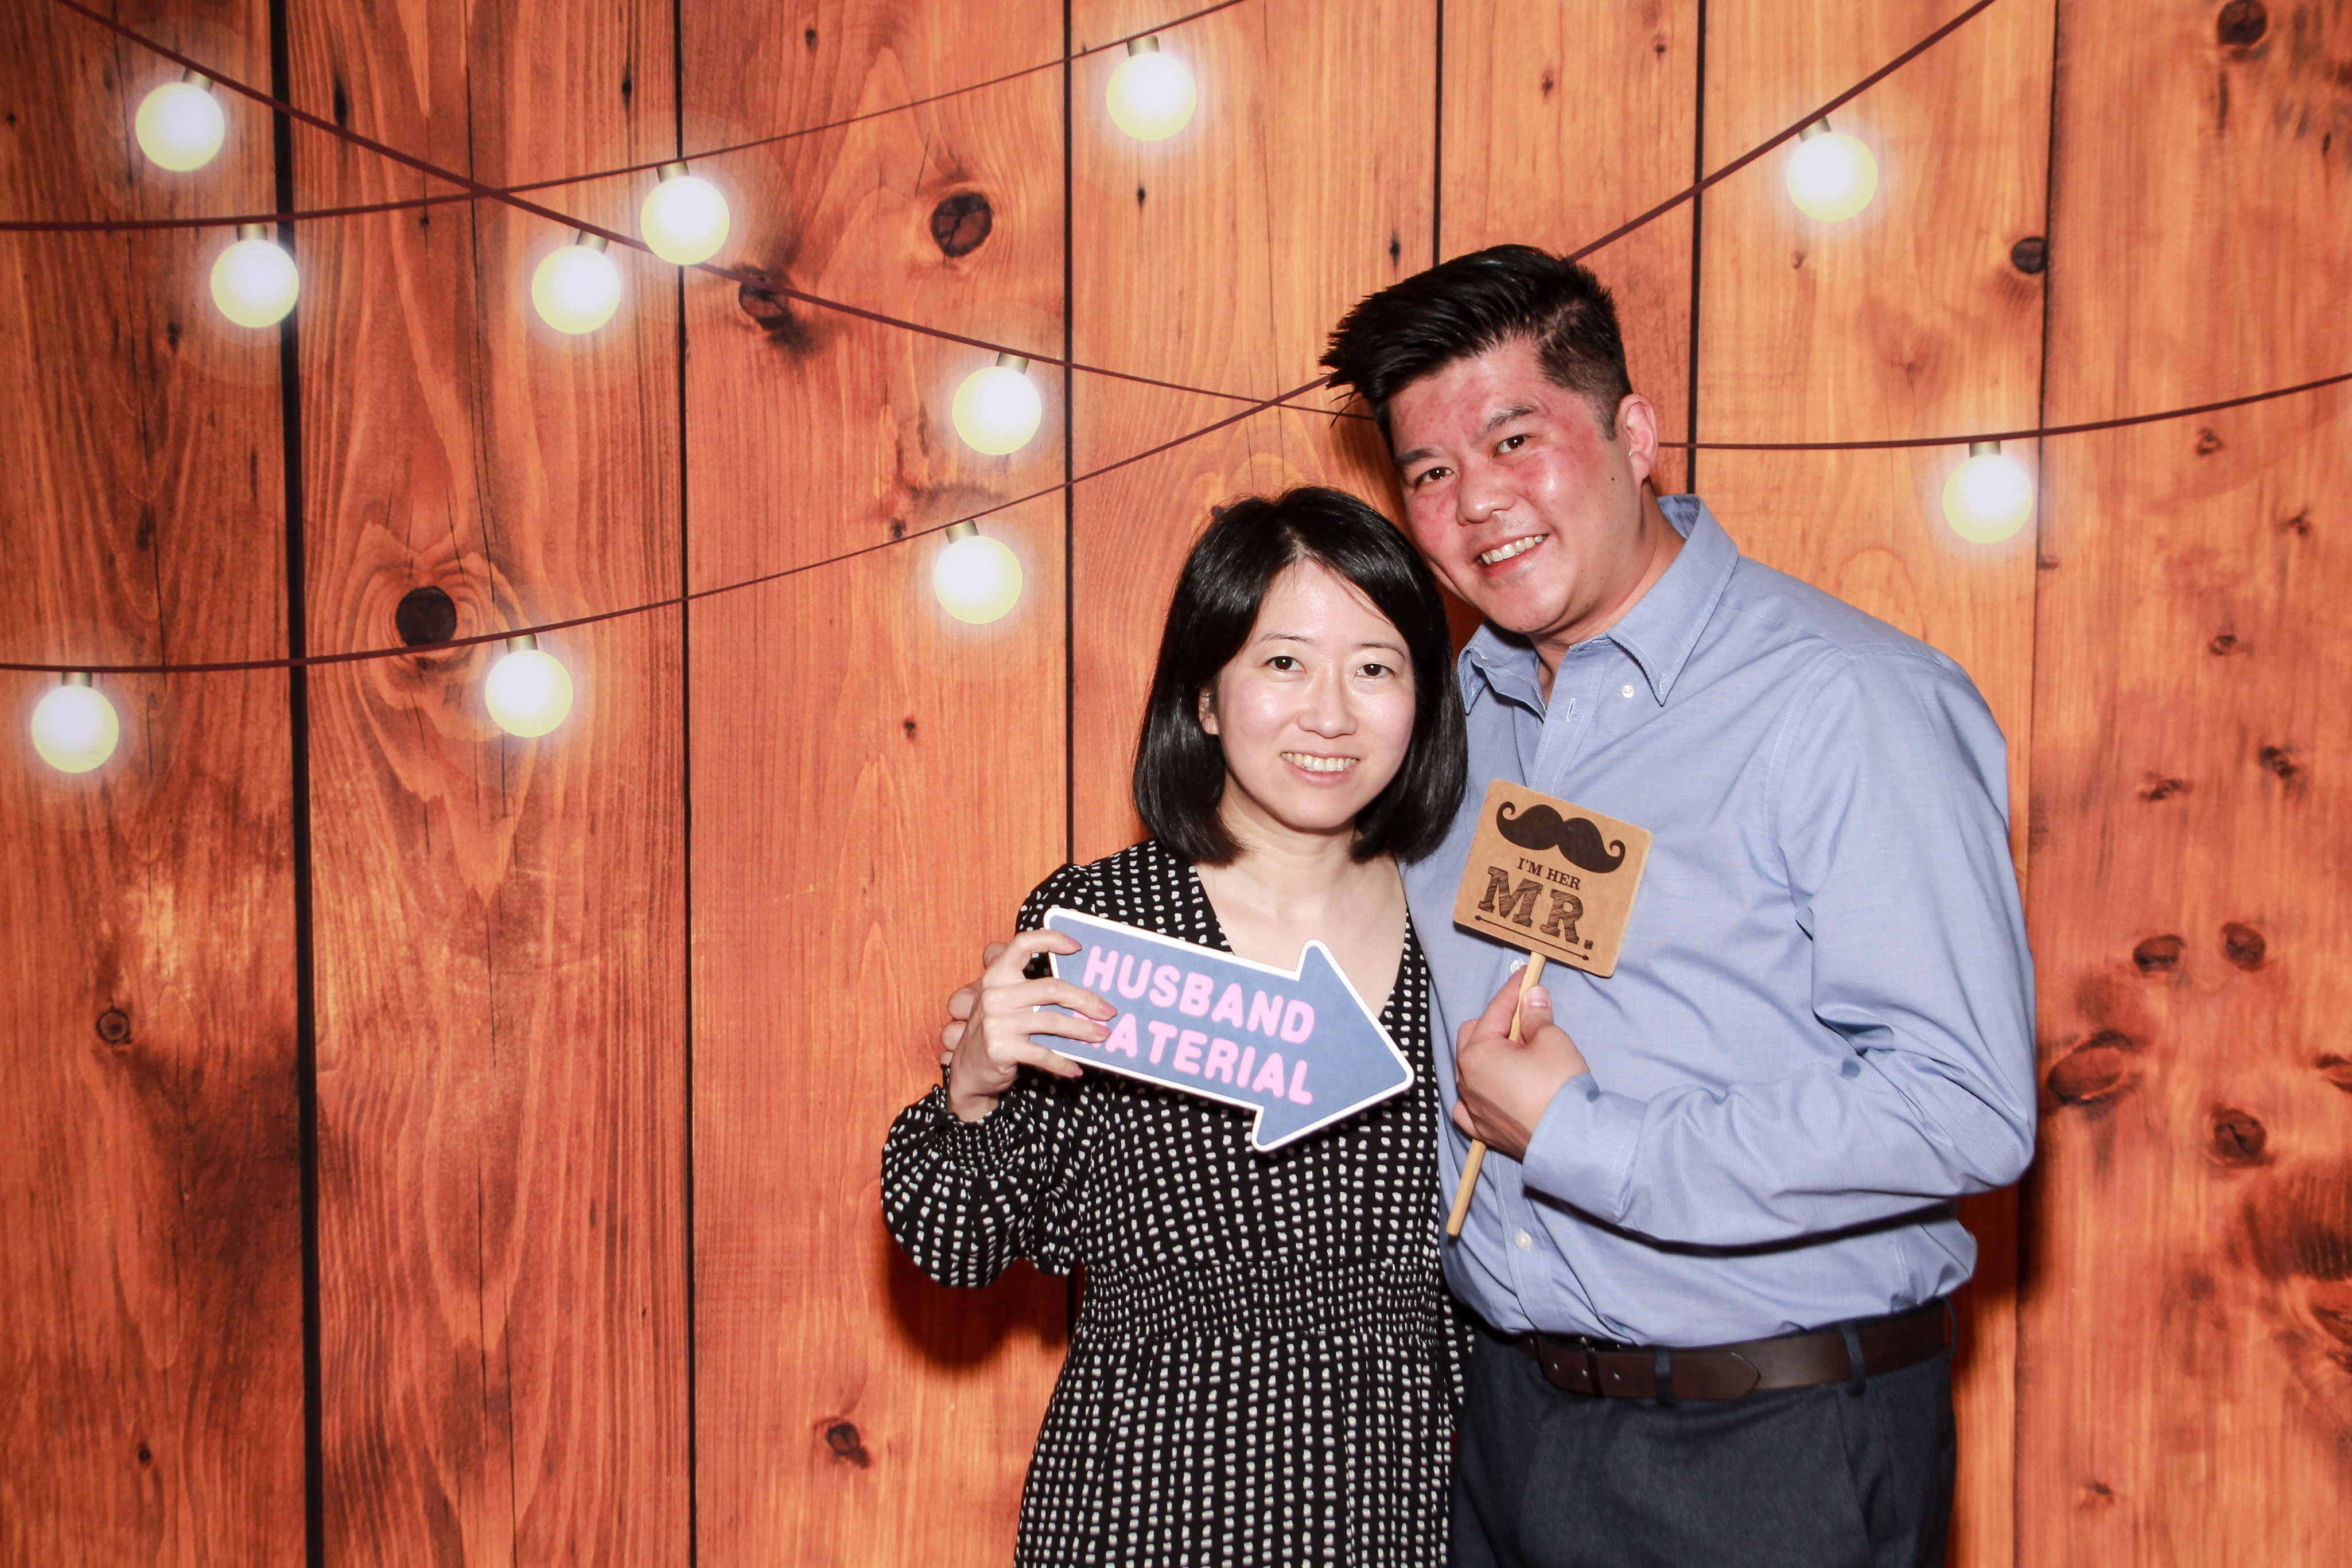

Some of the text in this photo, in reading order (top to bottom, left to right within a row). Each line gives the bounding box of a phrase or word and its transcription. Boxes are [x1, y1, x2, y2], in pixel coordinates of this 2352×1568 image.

[1478, 866, 1593, 950] MR.
[1517, 857, 1581, 890] I'M HER
[1083, 946, 1315, 1044] HUSBAND
[1070, 1011, 1313, 1105] ATERIAL
